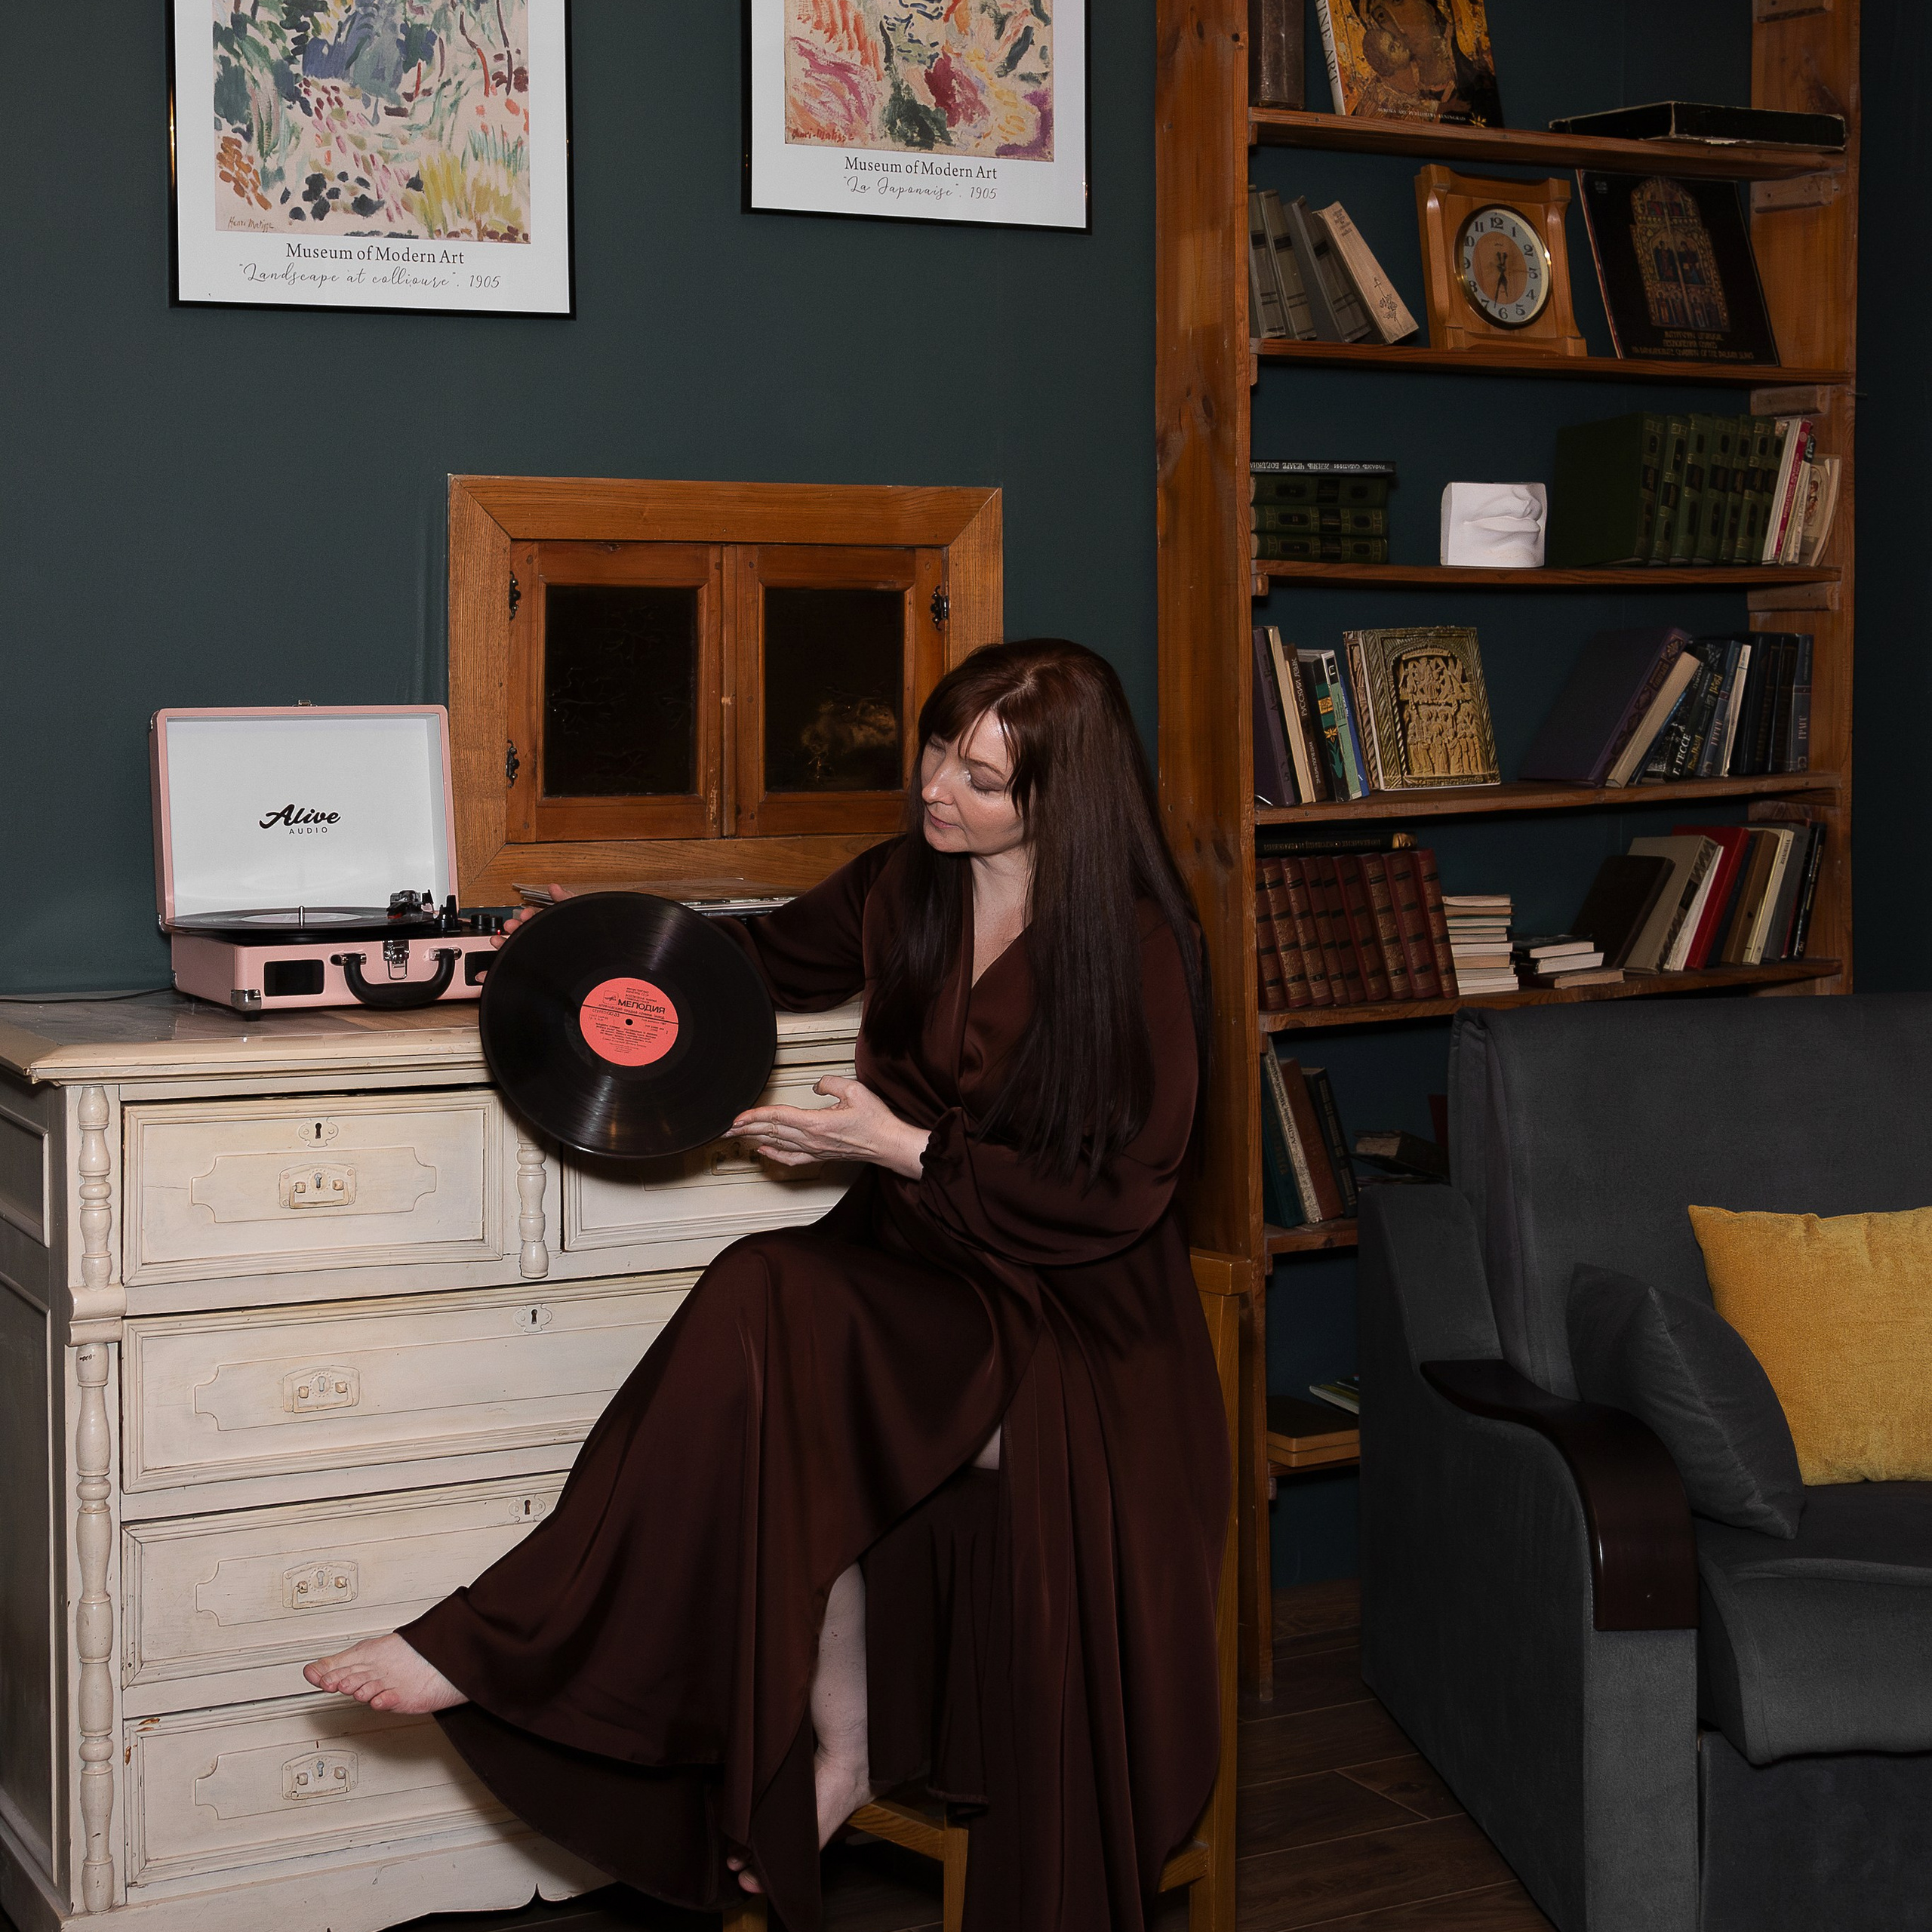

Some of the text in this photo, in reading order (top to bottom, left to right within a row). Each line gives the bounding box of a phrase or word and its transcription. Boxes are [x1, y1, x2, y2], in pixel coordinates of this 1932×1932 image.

[1324, 50, 1338, 83] ART
[844, 155, 997, 180] Museum of Modern Art
[971, 186, 997, 199] 1905
[1475, 221, 1484, 233] 11
[1491, 217, 1503, 229] 12
[1512, 226, 1516, 238] 1
[286, 242, 464, 264] Museum of Modern Art
[1524, 244, 1534, 257] 2
[1463, 257, 1471, 269] 9
[346, 268, 367, 284] at
[469, 275, 502, 288] 1905
[1529, 267, 1539, 279] 3
[1469, 281, 1478, 293] 8
[1525, 289, 1537, 300] 4
[1481, 298, 1490, 311] 7
[1515, 303, 1526, 316] 5
[1498, 307, 1509, 320] 6
[1282, 462, 1305, 470] ЧЕЗАРЕ
[1291, 657, 1308, 717] РУССКИЙ ЯЗЫК
[1675, 733, 1691, 766] ГЕССЕ
[259, 804, 341, 829] Alive
[289, 826, 328, 835] AUDIO
[618, 998, 666, 1014] МЕЛОДИЯ
